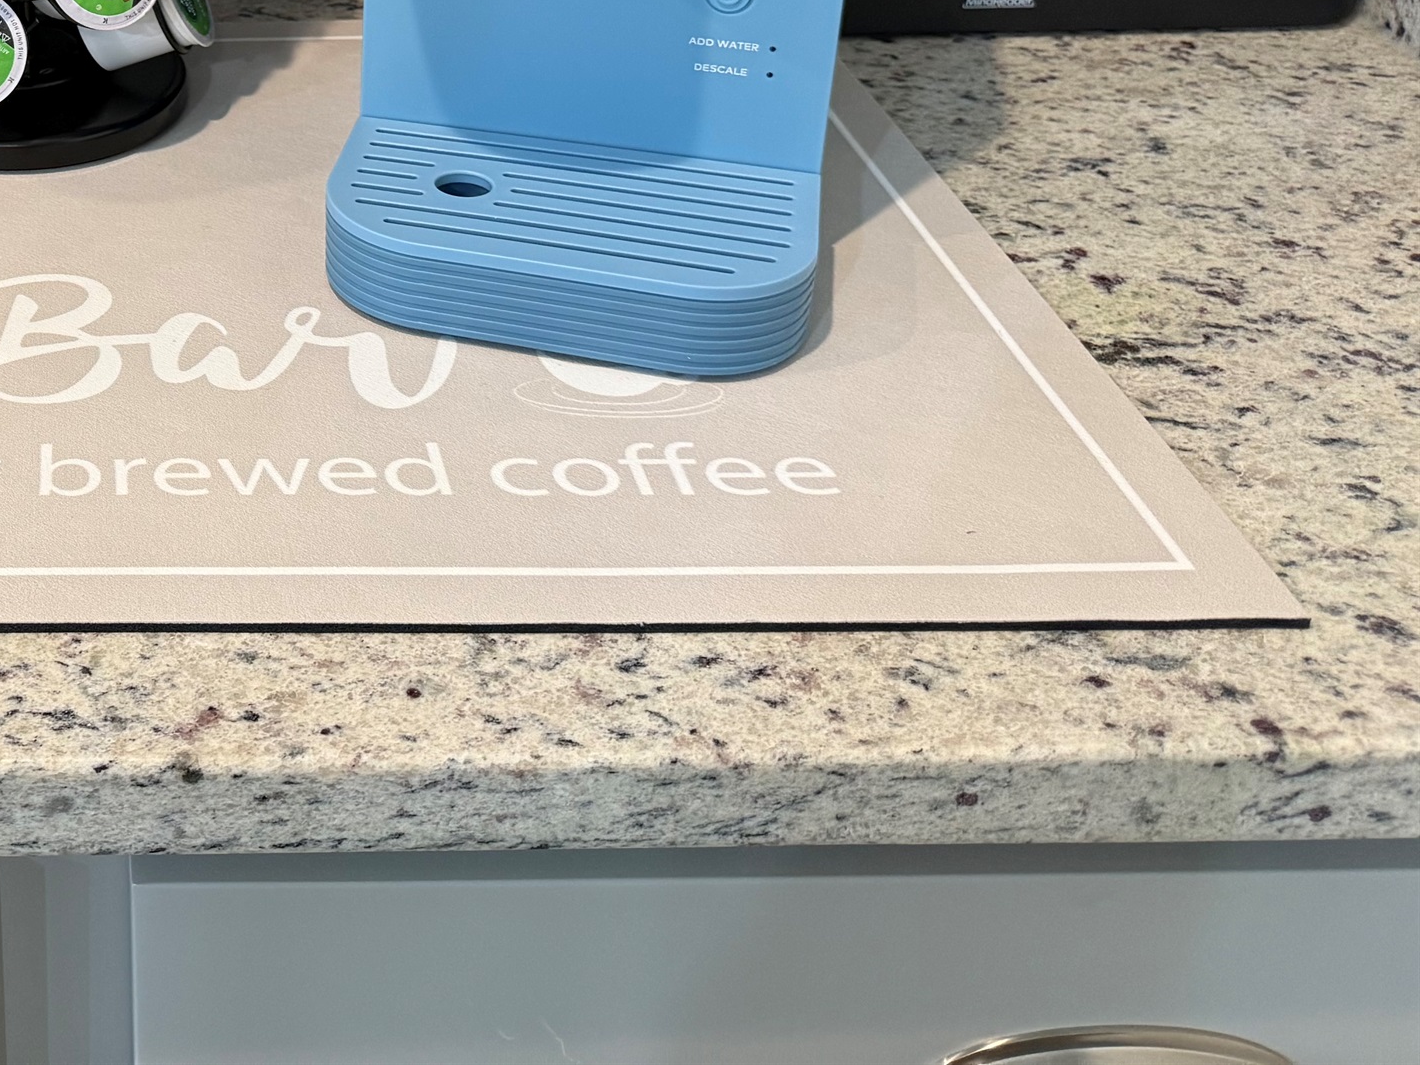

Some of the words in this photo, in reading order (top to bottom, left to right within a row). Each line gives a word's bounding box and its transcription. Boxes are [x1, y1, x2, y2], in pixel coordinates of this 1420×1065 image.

[688, 36, 715, 47] ADD
[717, 38, 760, 53] WATER
[693, 62, 749, 77] DESCALE
[39, 442, 454, 497] brewed
[490, 441, 841, 497] coffee
